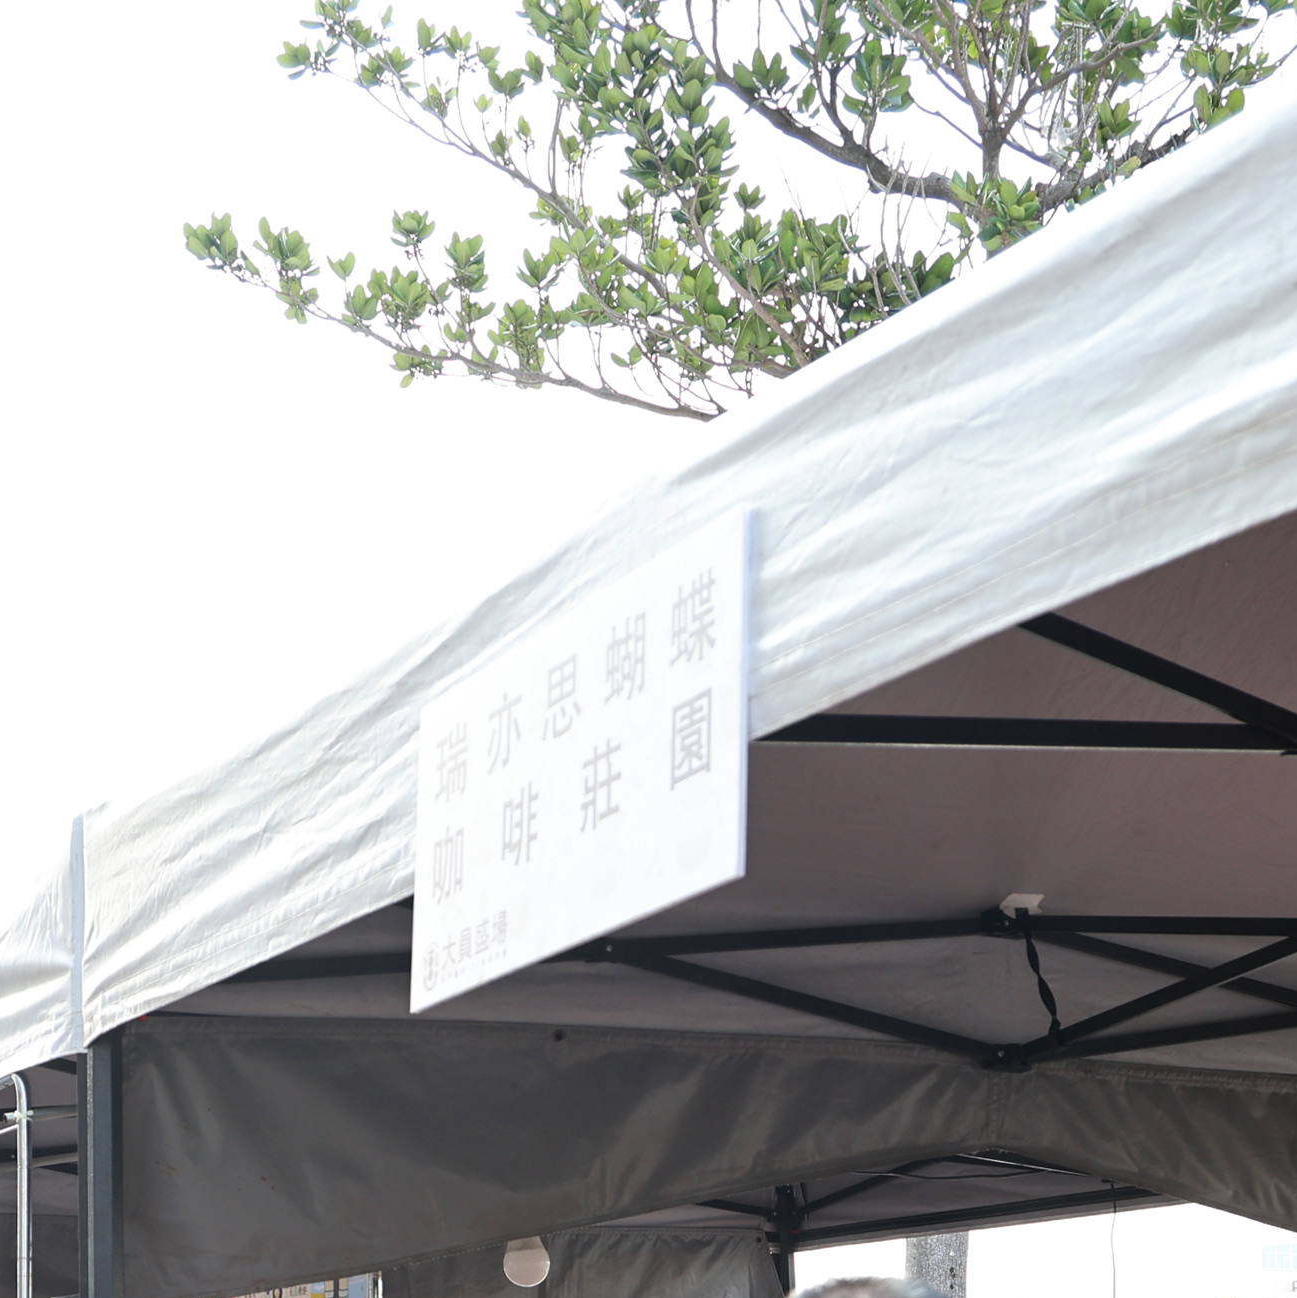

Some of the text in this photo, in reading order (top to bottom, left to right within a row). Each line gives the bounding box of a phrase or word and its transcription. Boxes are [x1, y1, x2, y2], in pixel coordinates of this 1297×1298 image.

[431, 688, 713, 903] 咖啡莊園
[435, 568, 717, 804] 瑞亦思蝴蝶
